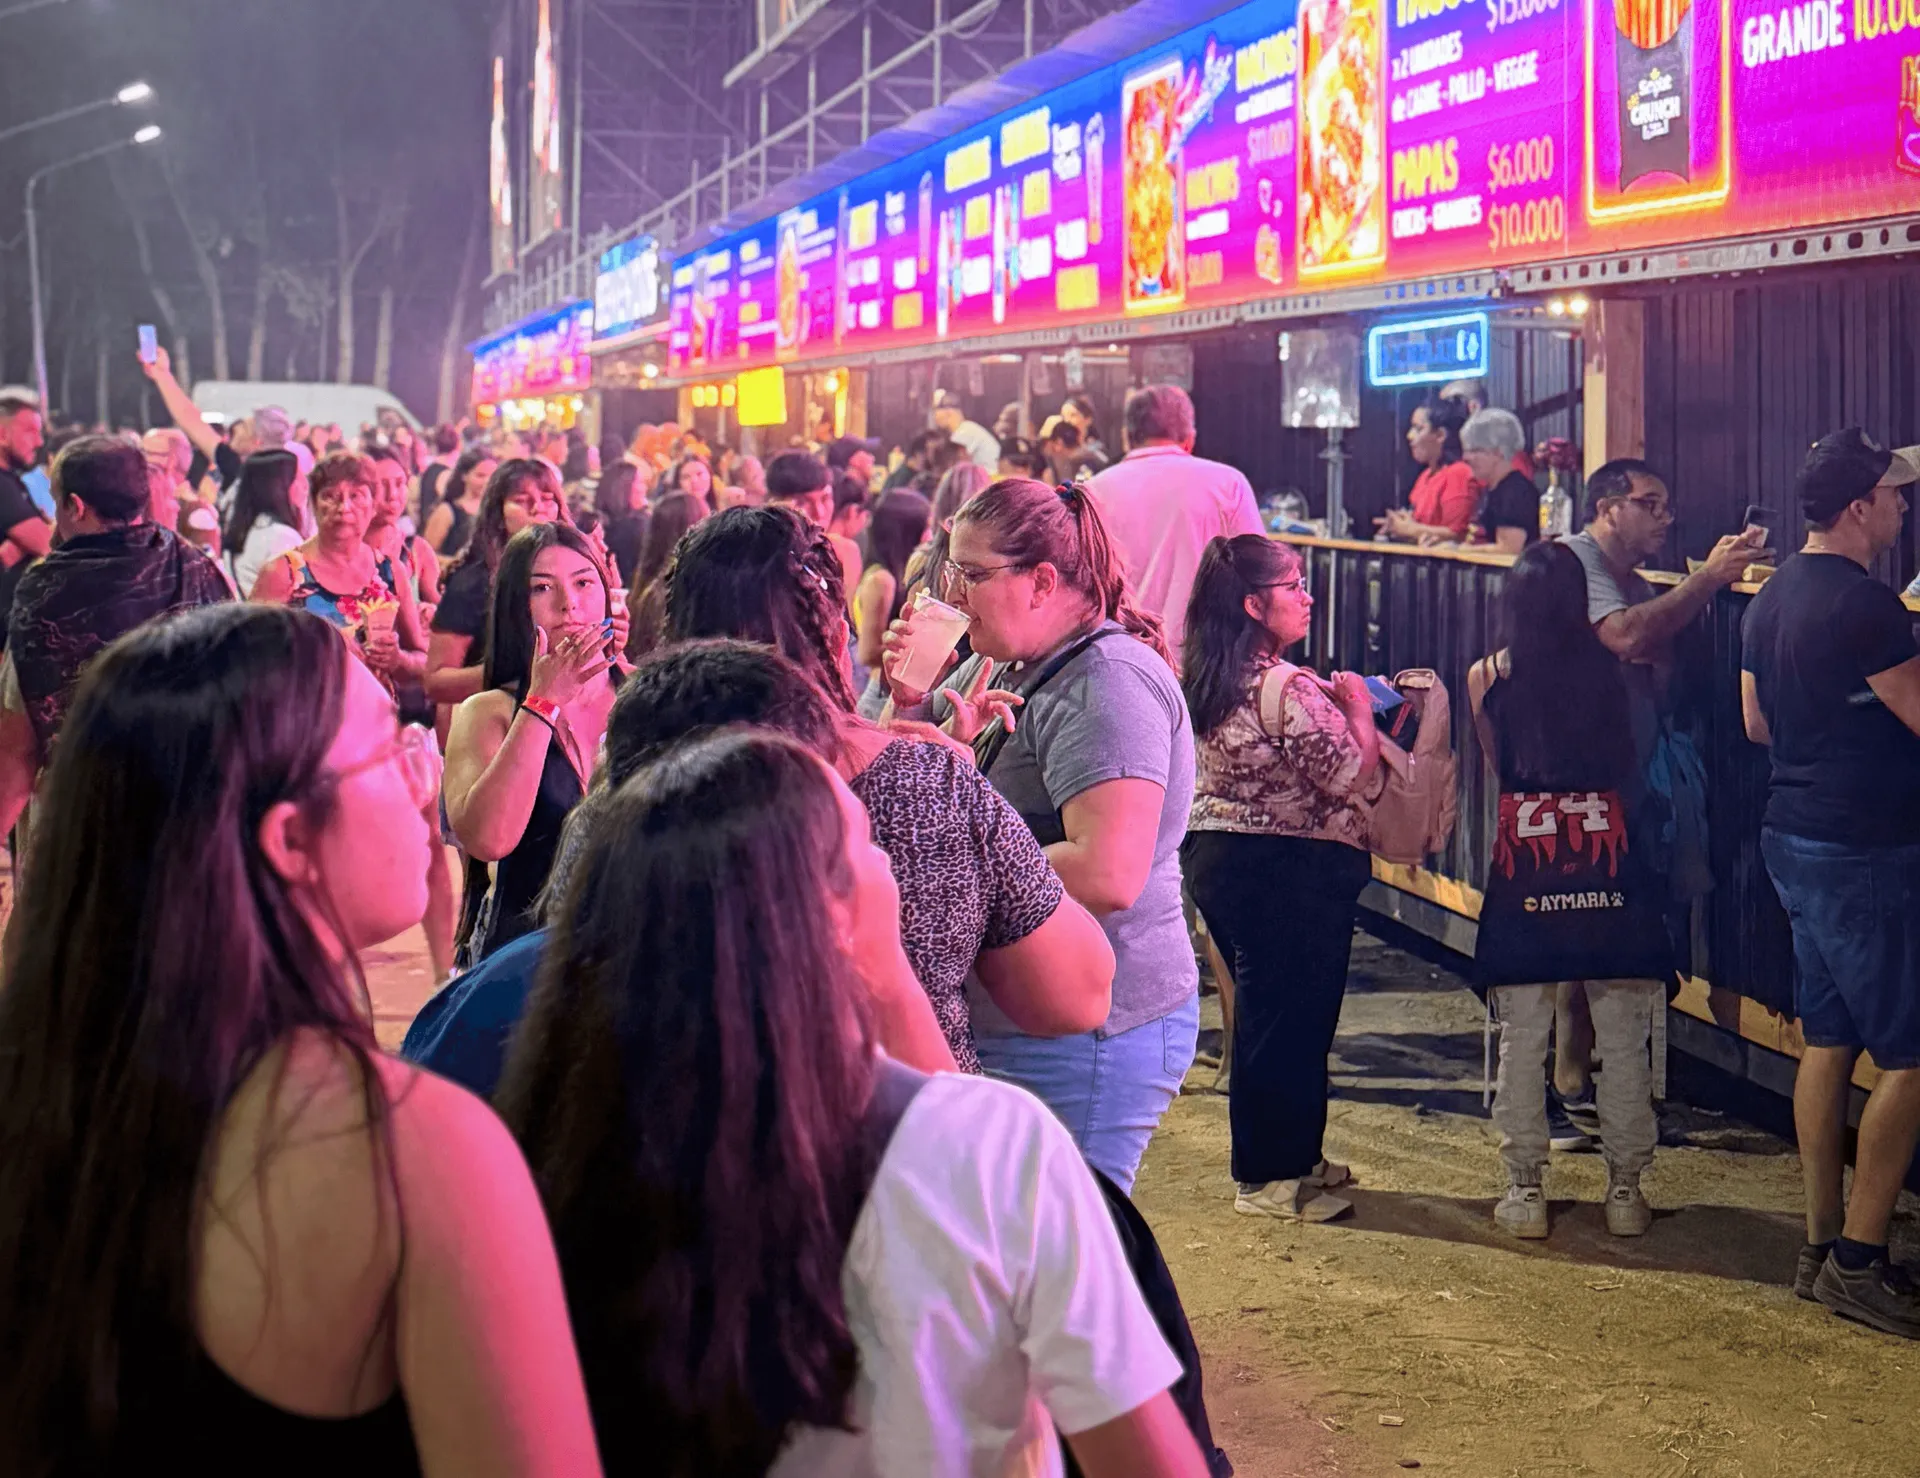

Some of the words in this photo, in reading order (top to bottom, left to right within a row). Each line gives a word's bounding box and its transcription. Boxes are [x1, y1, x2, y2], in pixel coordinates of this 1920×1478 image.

[1742, 0, 1846, 69] GRANDE
[1448, 67, 1485, 106] POLLO
[1392, 136, 1459, 203] PAPAS
[1488, 135, 1554, 194] $6.000
[1488, 195, 1564, 254] $10.000
[1513, 792, 1610, 838] 24
[1540, 891, 1610, 911] AYMARA
